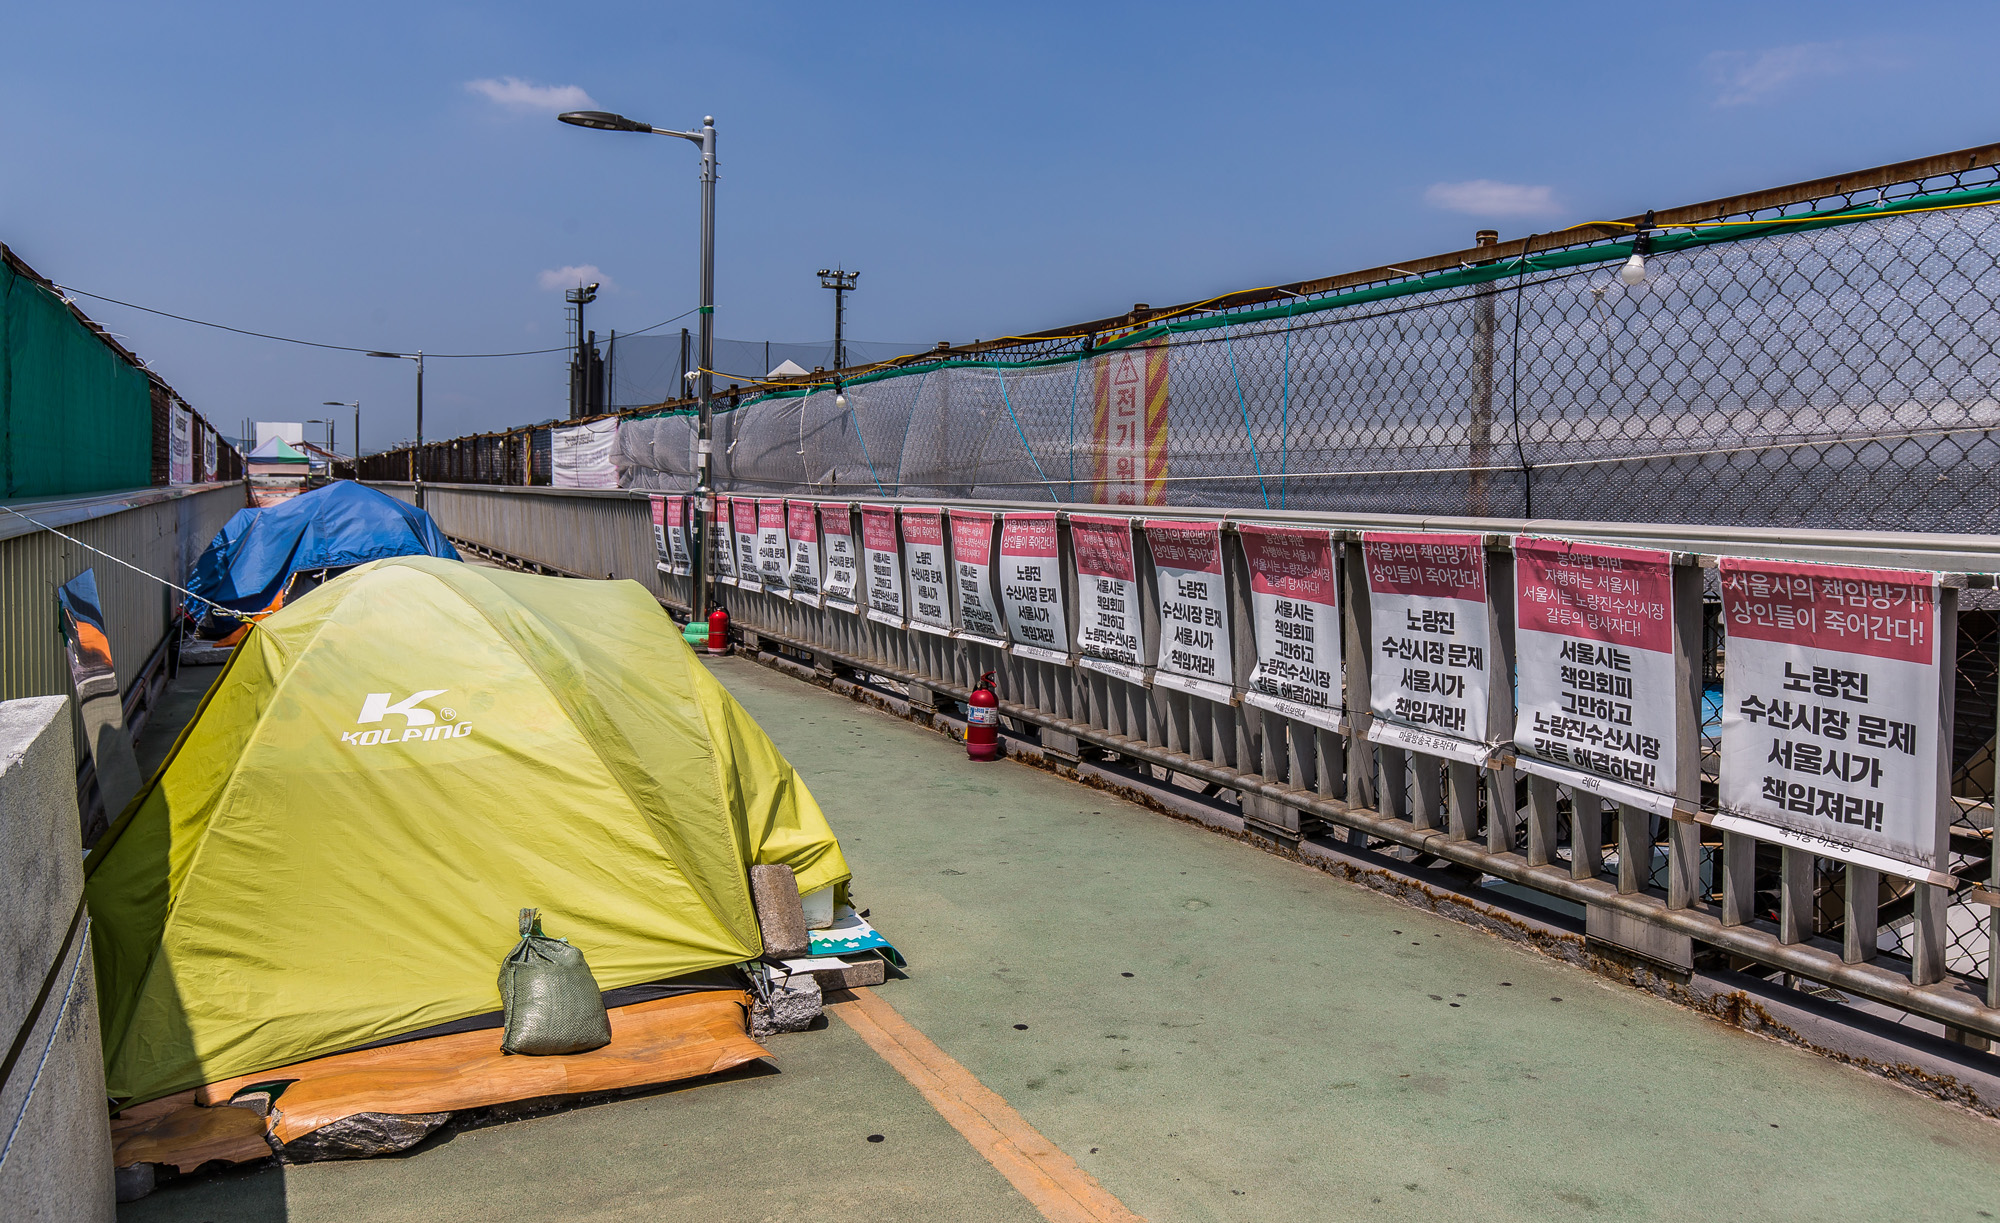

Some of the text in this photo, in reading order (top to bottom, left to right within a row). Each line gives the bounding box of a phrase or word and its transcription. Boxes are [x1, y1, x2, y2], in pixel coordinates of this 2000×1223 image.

[1150, 528, 1181, 544] 서울시의
[1154, 544, 1187, 561] 상인들이
[1260, 546, 1291, 560] 자행하는
[1369, 542, 1479, 566] 서울시의 책임방기!
[1556, 551, 1623, 573] 농안법 위반
[1016, 565, 1042, 582] 노량진
[1252, 558, 1330, 582] 서울시는 노량진수산시장
[1372, 564, 1481, 590] 상인들이 죽어간다!
[1545, 569, 1640, 596] 자행하는 서울시!
[1006, 584, 1058, 604] 수산시장 문제
[1096, 578, 1124, 597] 서울시는
[1178, 579, 1208, 601] 노량진
[1266, 574, 1320, 594] 갈등의 당사자다!
[1728, 573, 1924, 614] 서울시의 책임방기!
[1018, 606, 1050, 623] 서울시가
[1162, 601, 1223, 629] 수산시장 문제
[1274, 600, 1314, 623] 서울시는
[1524, 586, 1666, 621] 서울시는 노량진수산시장
[1098, 612, 1125, 631] 그만하고
[1275, 619, 1314, 644] 책임회피
[1406, 608, 1456, 636] 노량진
[1546, 608, 1642, 638] 갈등의 당사자다!
[1732, 601, 1924, 646] 상인들이 죽어간다!
[1085, 626, 1138, 650] 노량진수산시장
[1174, 626, 1214, 651] 서울시가
[1171, 649, 1215, 677] 책임져라!
[1274, 640, 1314, 665] 그만하고
[1382, 636, 1484, 672] 수산시장 문제
[1560, 640, 1632, 674] 서울시는
[1258, 656, 1331, 689] 노량진수산시장
[1400, 668, 1466, 700] 서울시가
[1560, 665, 1634, 700] 책임회피
[1783, 662, 1869, 704] 노량진
[1394, 696, 1467, 732] 책임져라!
[1561, 691, 1633, 727] 그만하고
[341, 721, 473, 746] KOLPING
[1532, 710, 1661, 761] 노량진수산시장
[1740, 694, 1917, 757] 수산시장 문제
[1534, 737, 1656, 788] 갈등 해결하라!
[1767, 738, 1884, 788] 서울시가
[1762, 776, 1884, 833] 책임져라!
